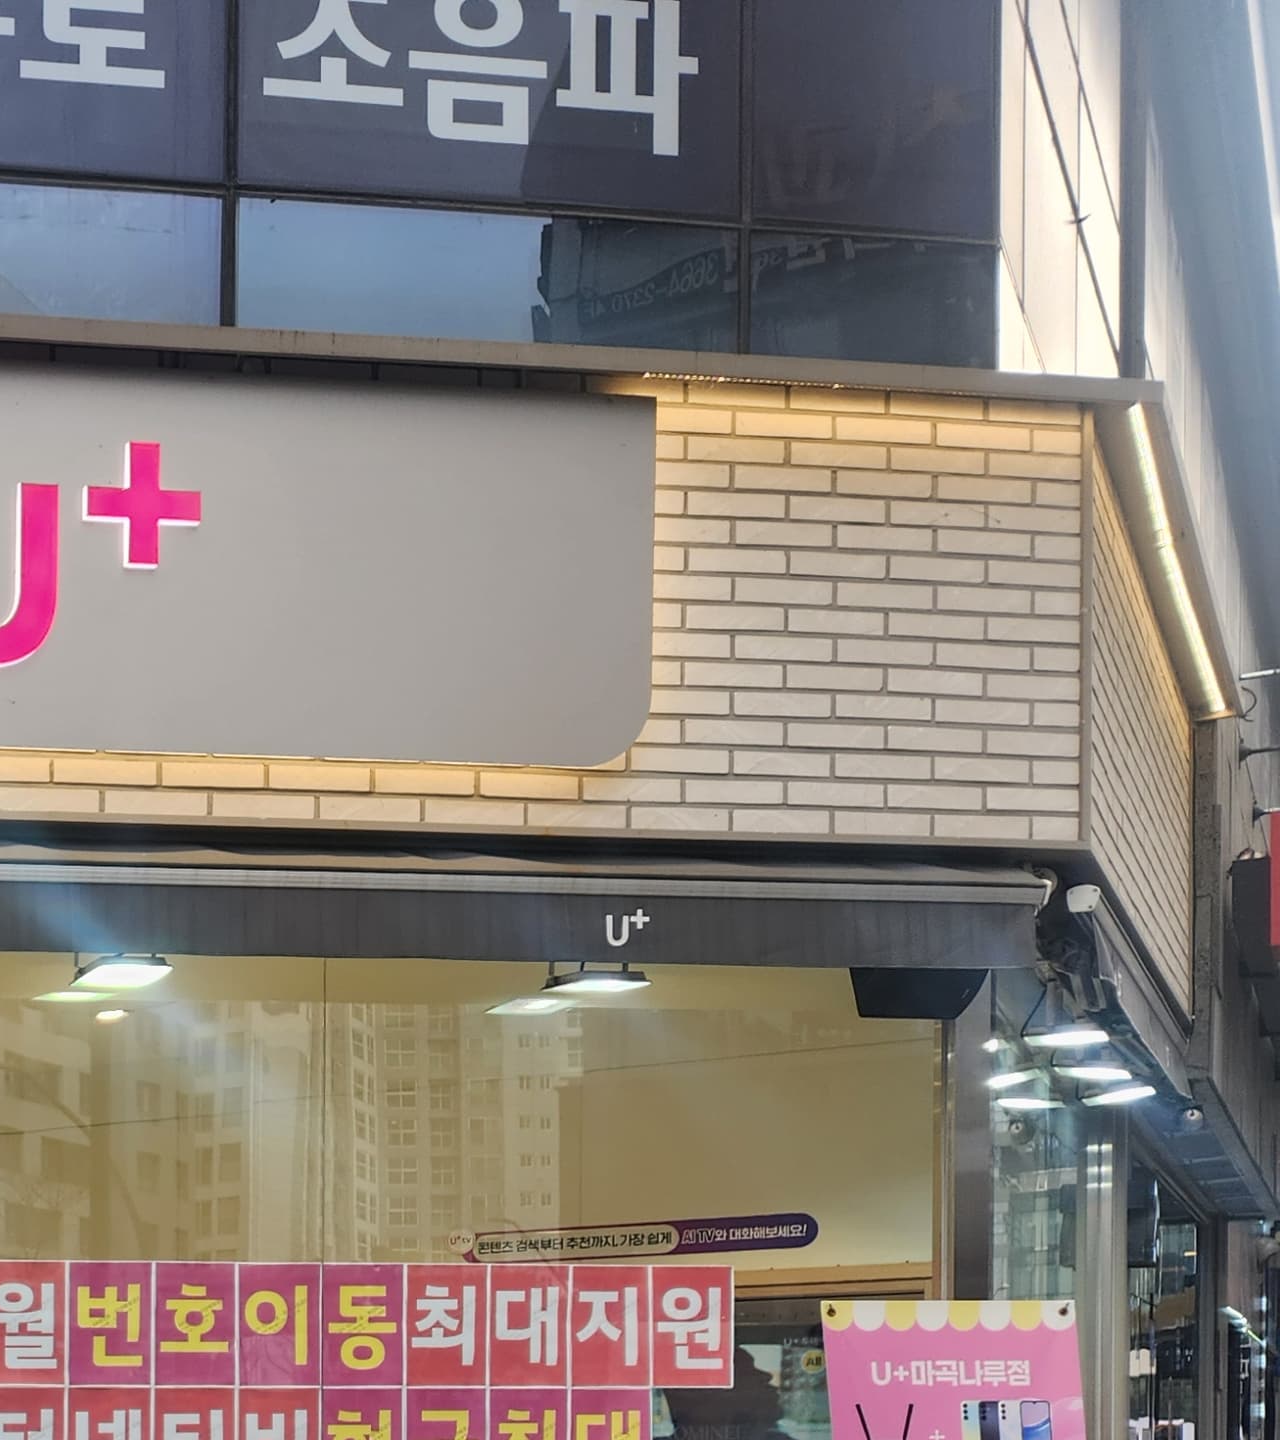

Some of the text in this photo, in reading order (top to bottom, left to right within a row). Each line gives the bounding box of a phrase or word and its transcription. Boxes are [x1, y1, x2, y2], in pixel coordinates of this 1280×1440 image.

[606, 909, 650, 947] U+
[477, 1240, 514, 1256] 콘텐츠
[516, 1236, 564, 1253] 검색부터
[620, 1232, 645, 1248] 가장
